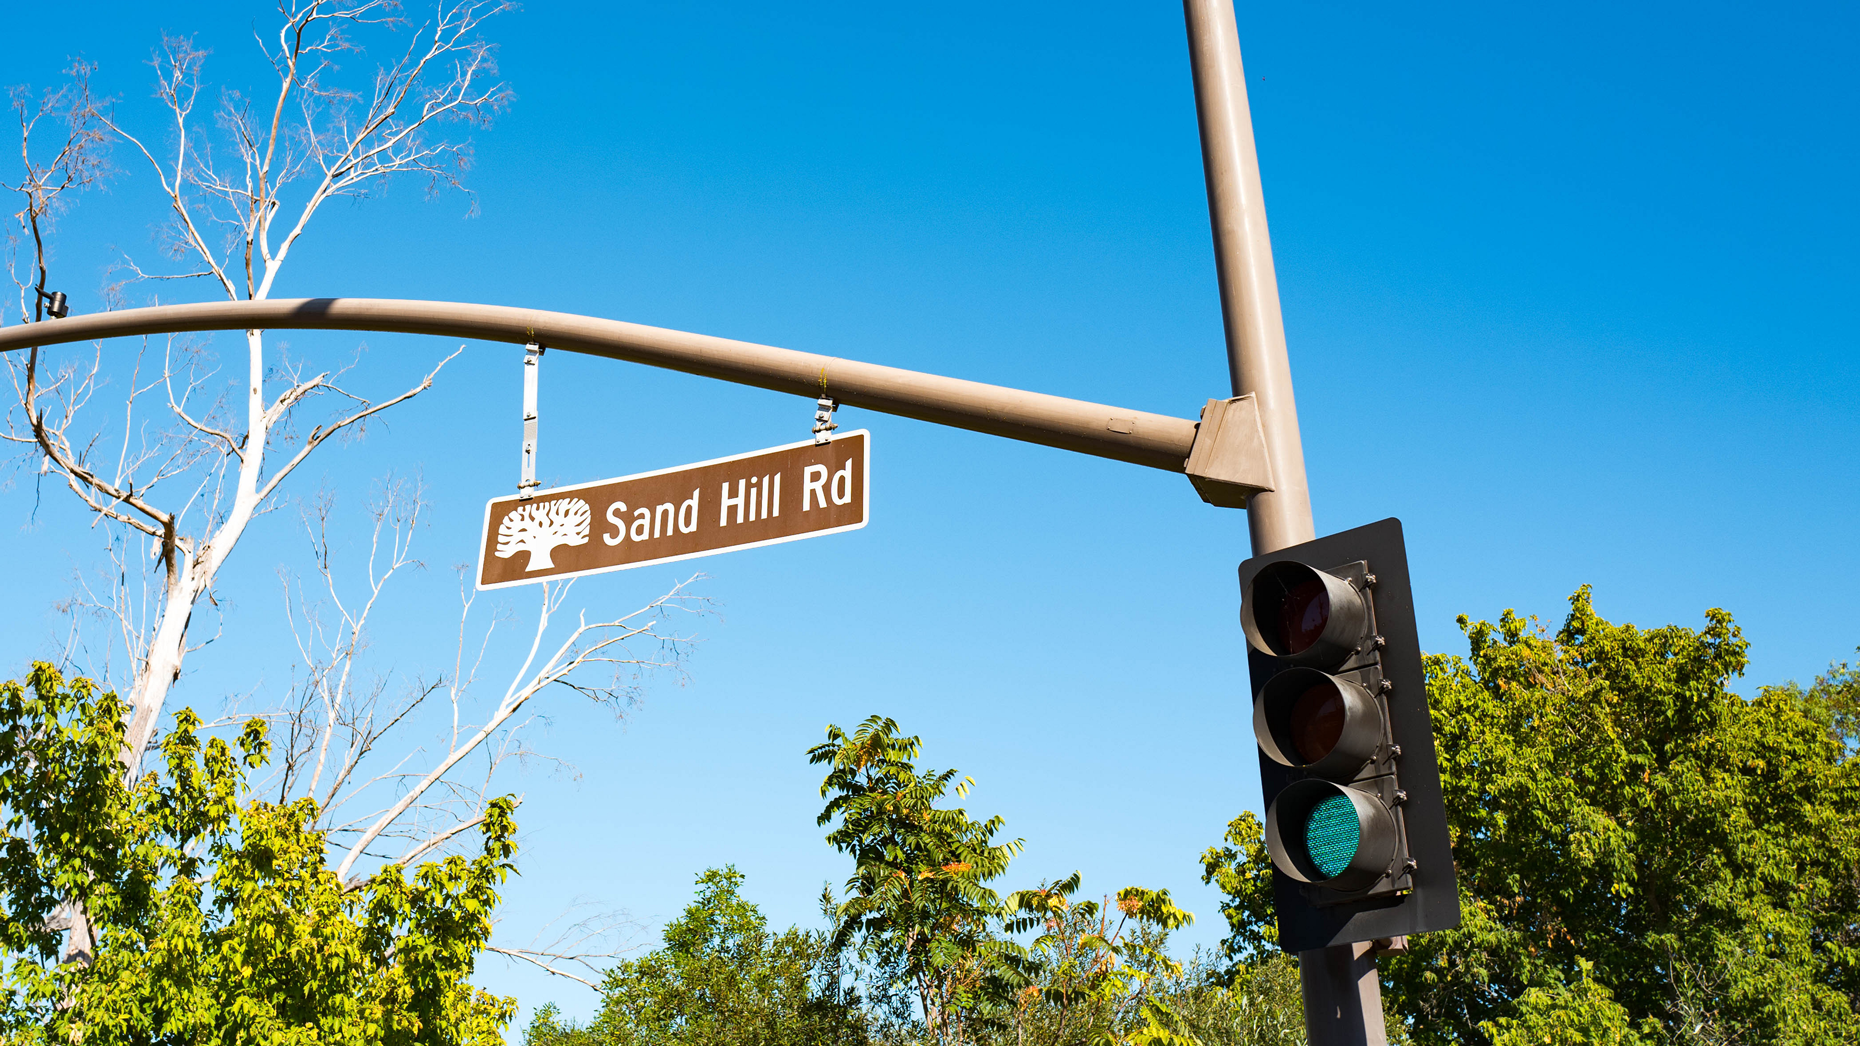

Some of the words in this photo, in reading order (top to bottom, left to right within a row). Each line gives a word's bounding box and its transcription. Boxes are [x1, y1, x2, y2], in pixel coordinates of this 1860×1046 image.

[602, 487, 700, 547] Sand
[719, 471, 781, 527] Hill
[802, 457, 853, 512] Rd
